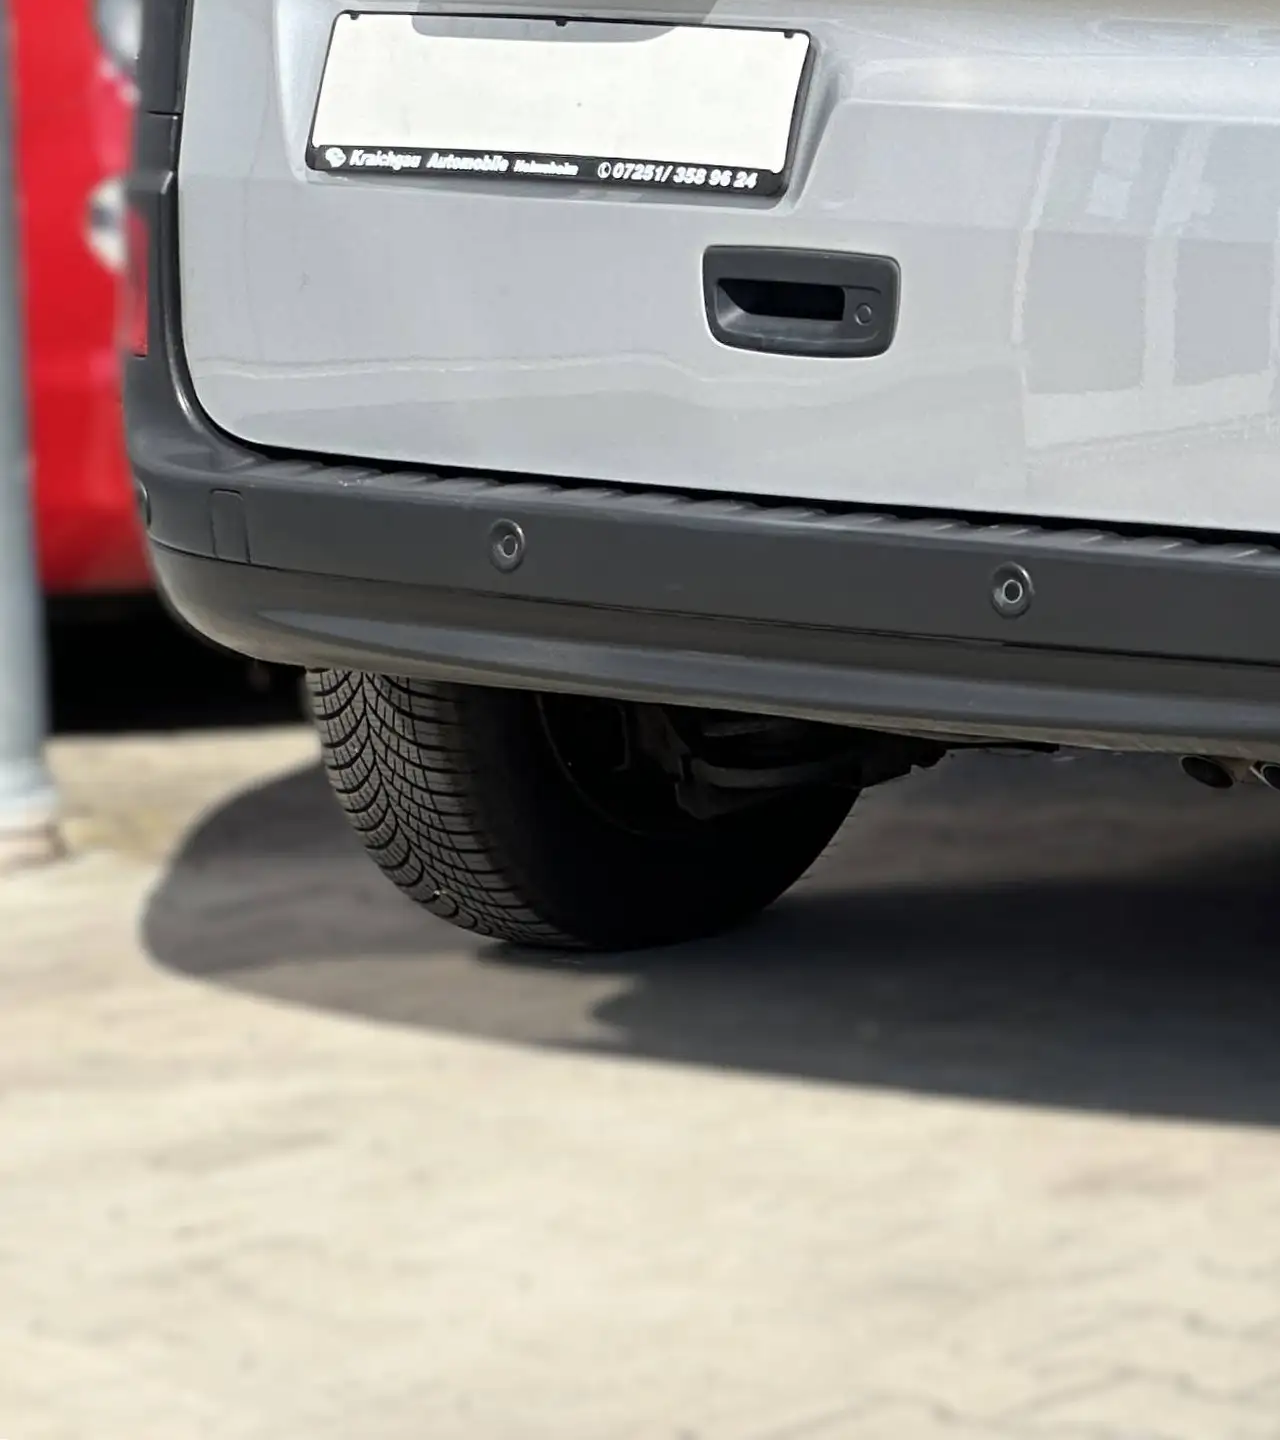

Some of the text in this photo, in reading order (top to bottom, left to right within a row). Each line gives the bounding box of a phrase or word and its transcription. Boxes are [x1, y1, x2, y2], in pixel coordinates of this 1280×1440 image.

[350, 150, 423, 172] Kraichgau
[426, 153, 510, 174] Automobile
[612, 161, 673, 183] 07251/
[673, 166, 707, 185] 358
[708, 169, 733, 188] 96
[733, 171, 758, 189] 24
